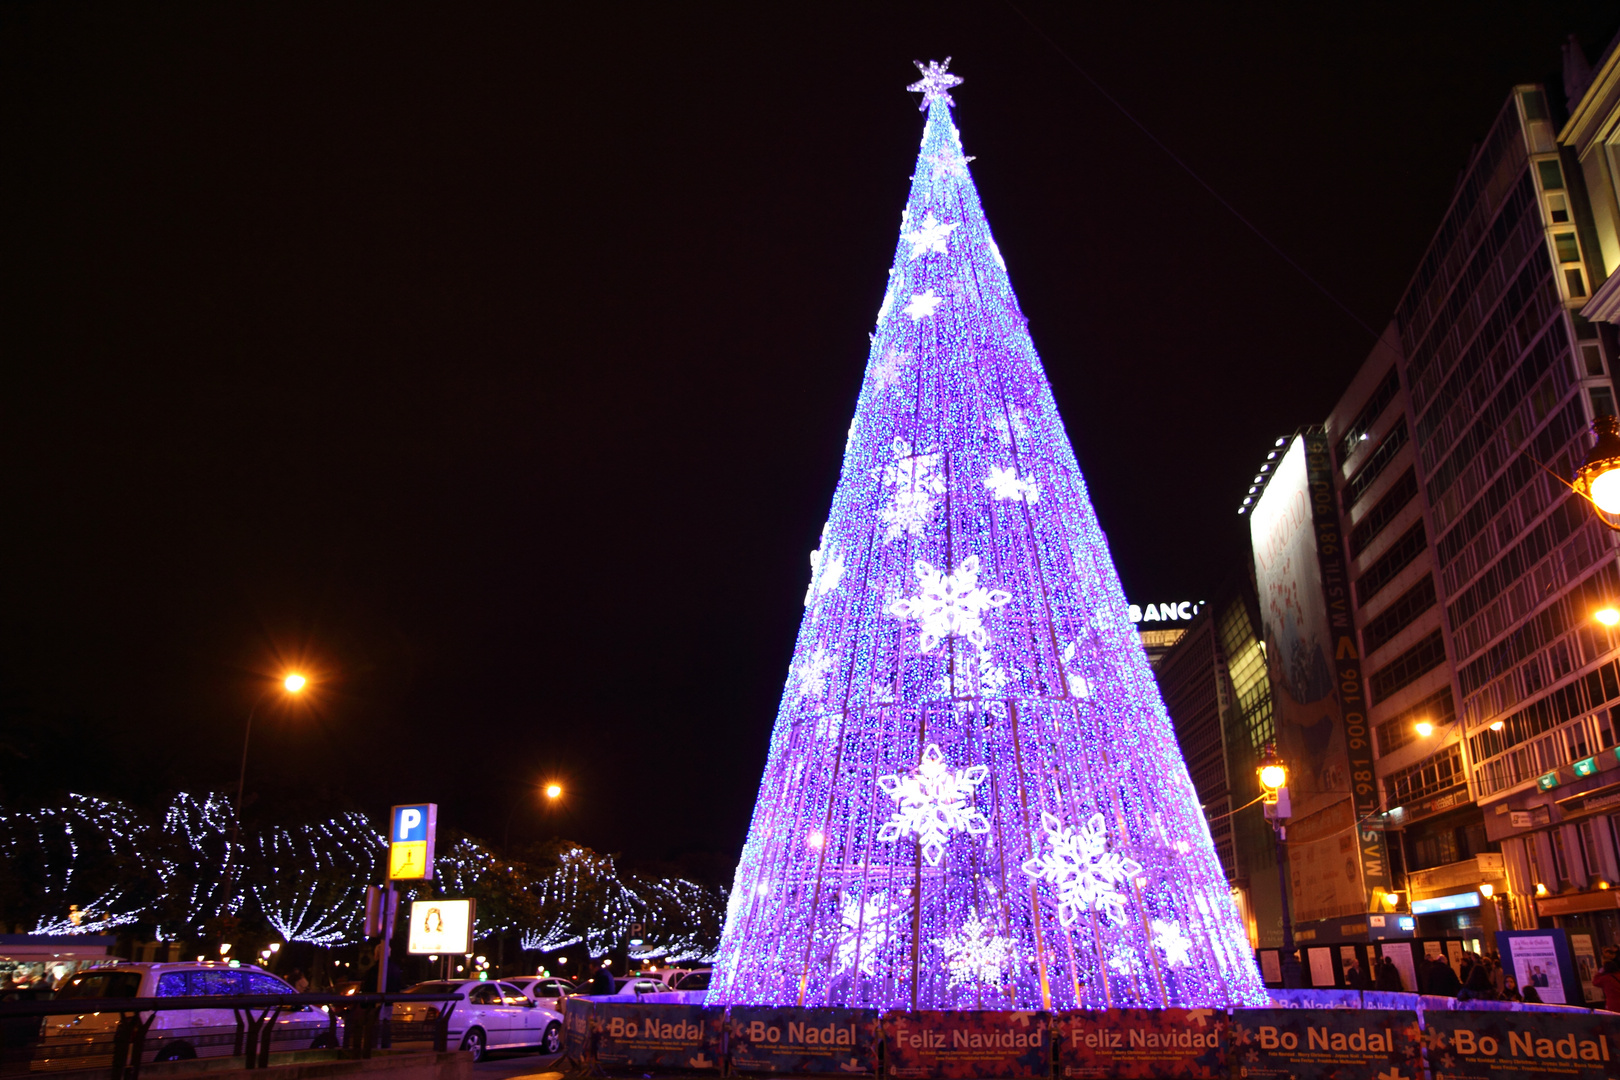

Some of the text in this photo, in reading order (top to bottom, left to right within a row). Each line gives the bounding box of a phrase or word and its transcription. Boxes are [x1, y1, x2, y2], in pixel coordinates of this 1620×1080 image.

[1314, 481, 1332, 514] 900
[1320, 521, 1339, 555] 981
[1340, 668, 1360, 703] 106
[1346, 712, 1367, 750] 900
[1354, 759, 1374, 796] 981
[400, 809, 421, 839] P
[610, 1017, 638, 1038] Bo
[644, 1017, 705, 1040] Nadal
[750, 1021, 857, 1045] Bo Nadal
[896, 1028, 1043, 1048] Feliz Navidad
[1071, 1028, 1220, 1048] Feliz Navidad
[1259, 1025, 1394, 1053] Bo Nadal
[1453, 1029, 1611, 1062] Bo Nadal
